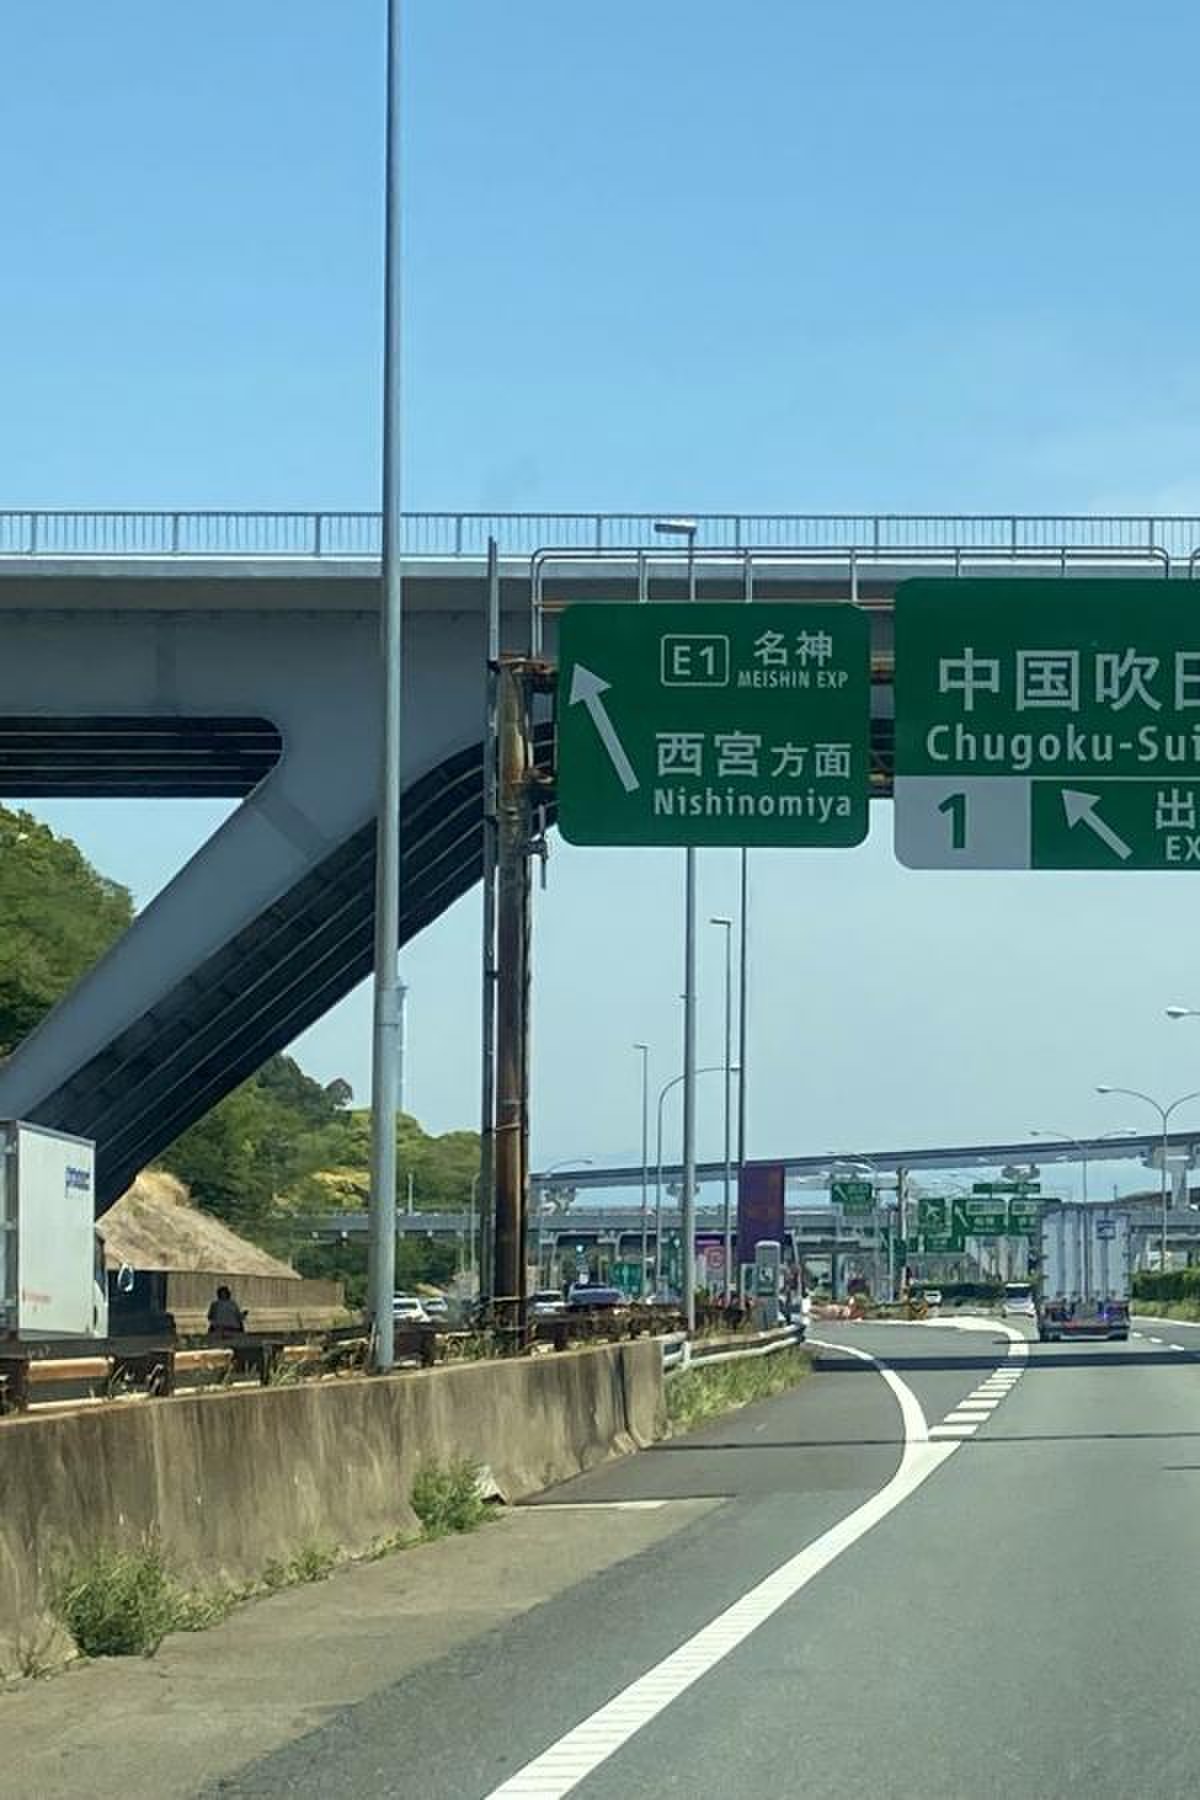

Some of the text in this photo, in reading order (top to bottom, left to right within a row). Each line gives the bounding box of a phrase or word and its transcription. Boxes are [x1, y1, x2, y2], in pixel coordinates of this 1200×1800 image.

[674, 646, 714, 676] E1
[754, 630, 832, 667] 名神
[738, 671, 848, 688] MEISHIN EXP
[656, 731, 851, 779] 西宮方面
[655, 787, 851, 821] Nishinomiya
[938, 794, 966, 849] 1
